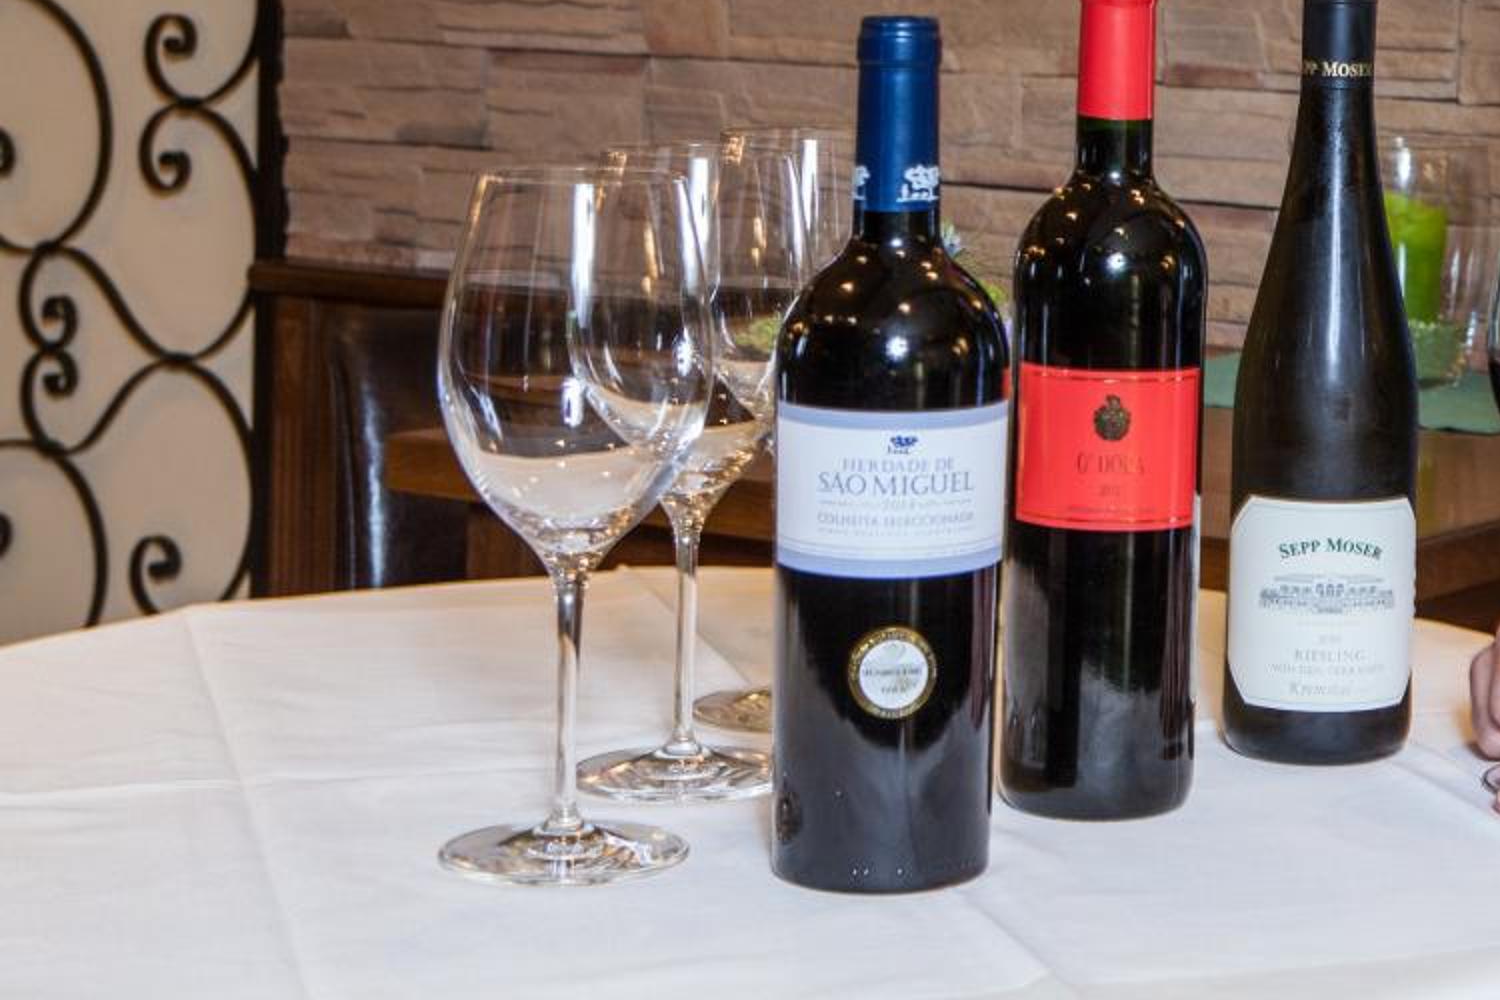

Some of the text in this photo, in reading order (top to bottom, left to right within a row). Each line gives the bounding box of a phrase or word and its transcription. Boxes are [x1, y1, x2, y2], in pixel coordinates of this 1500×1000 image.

[934, 457, 955, 472] DE
[872, 471, 974, 496] MIGUEL
[1294, 649, 1367, 663] RIESLING
